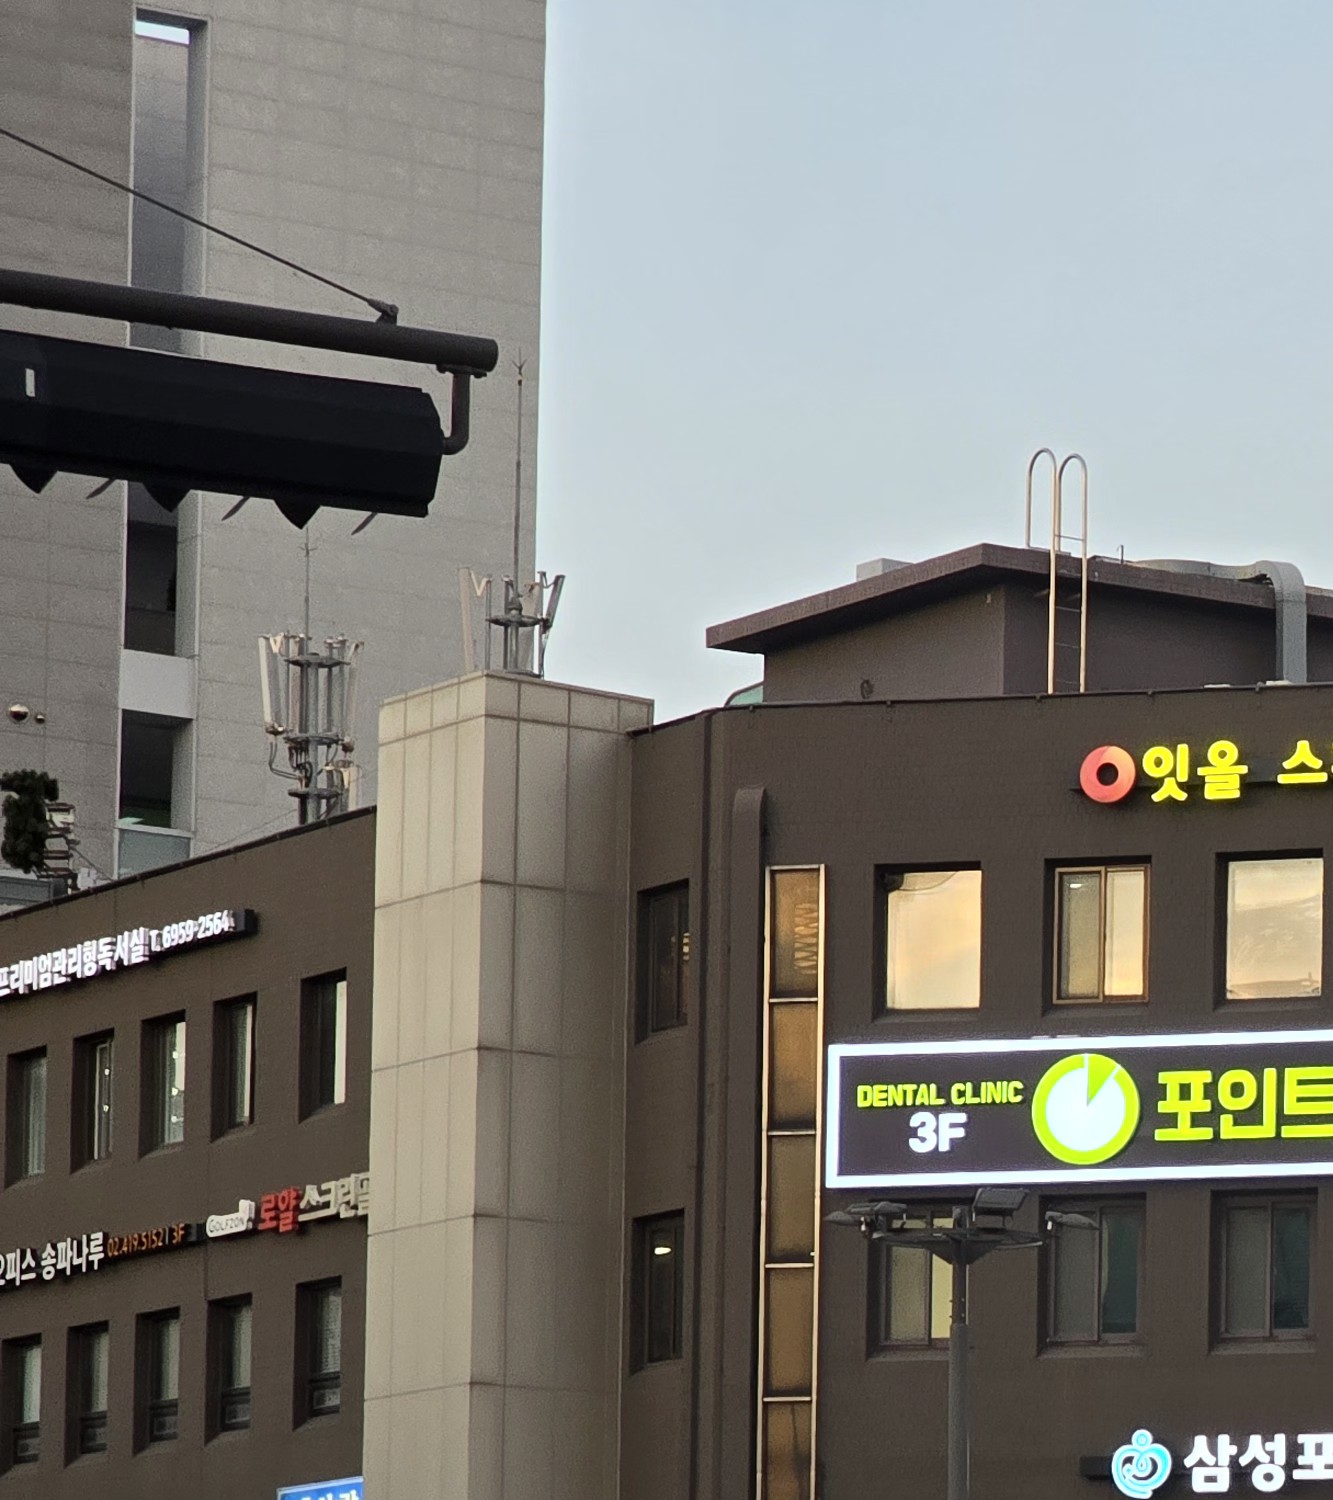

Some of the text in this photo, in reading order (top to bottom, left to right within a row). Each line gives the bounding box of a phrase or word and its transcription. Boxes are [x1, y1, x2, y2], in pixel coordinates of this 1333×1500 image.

[1142, 744, 1249, 803] 잇올
[162, 910, 232, 948] 6959-2564
[857, 1078, 1024, 1108] DENTAL CLINIC
[907, 1112, 969, 1154] 3F
[298, 1171, 369, 1221] 스크린골
[41, 1231, 105, 1280] 송파나루
